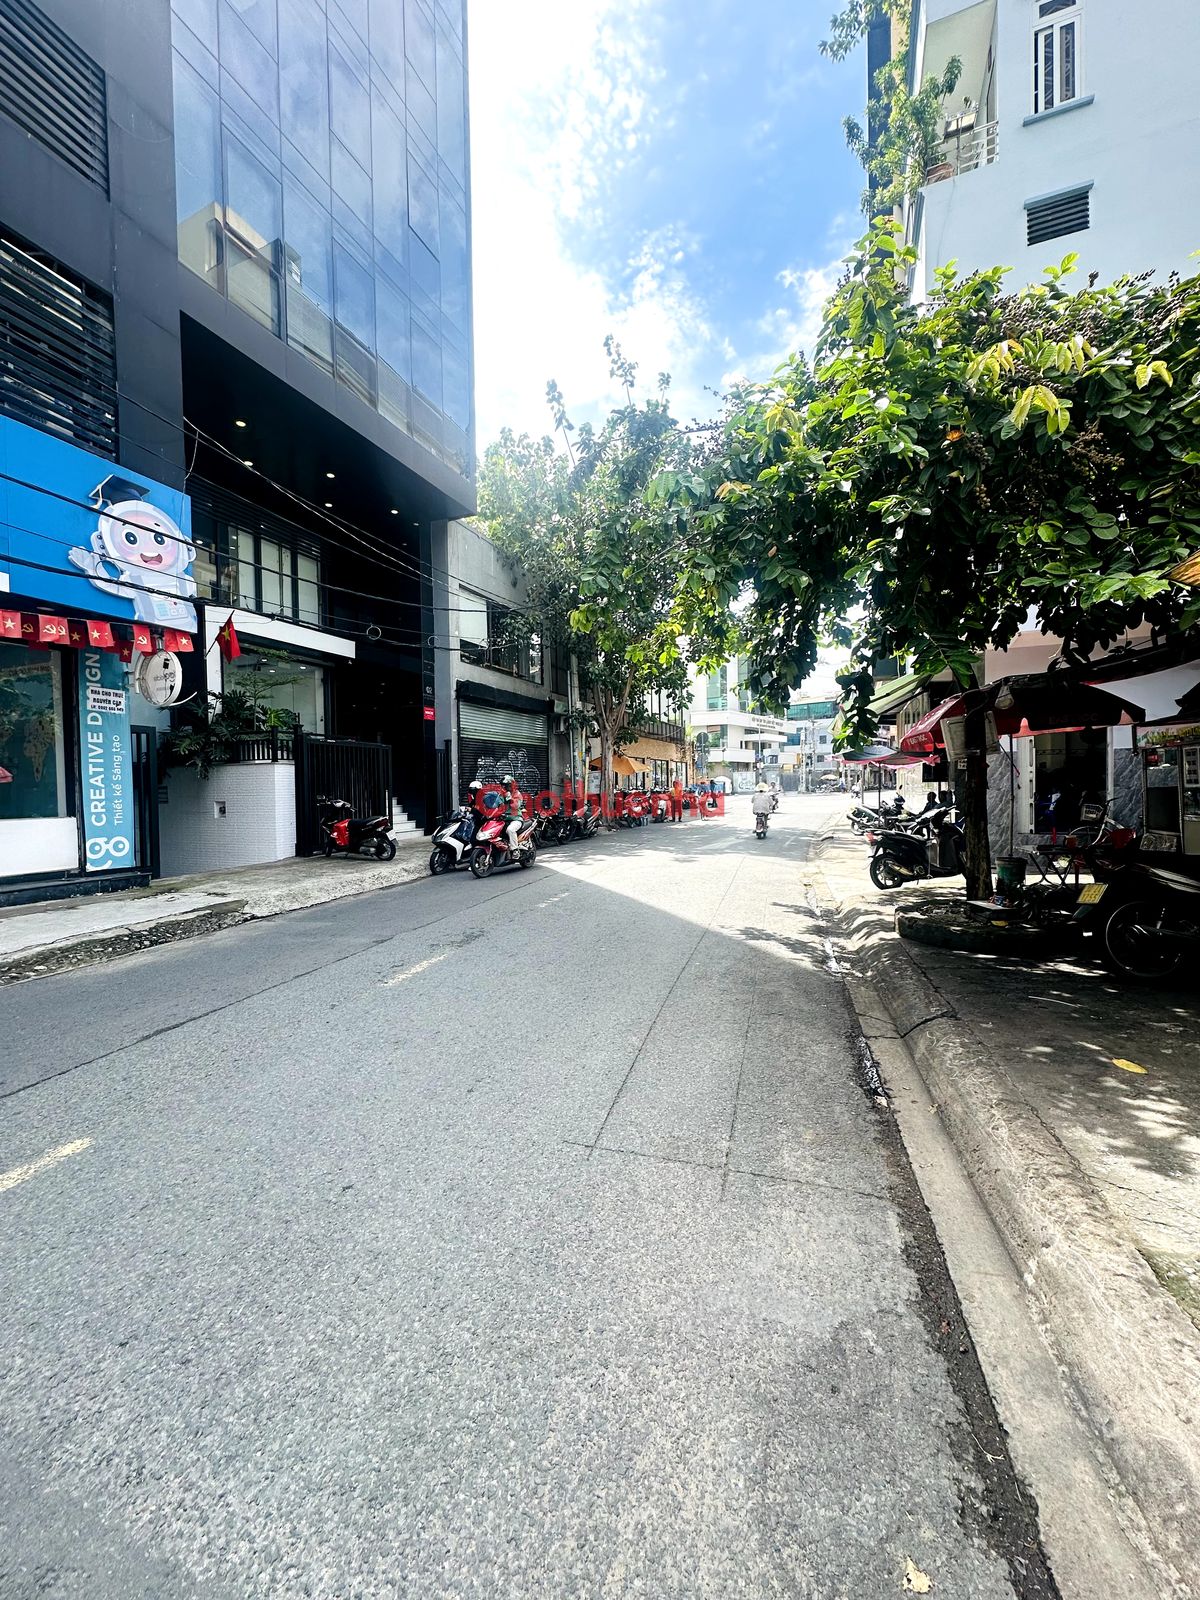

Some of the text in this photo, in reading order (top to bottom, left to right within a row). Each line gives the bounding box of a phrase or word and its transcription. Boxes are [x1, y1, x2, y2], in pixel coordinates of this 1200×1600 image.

[85, 653, 107, 827] CREATIVE DIGN
[111, 735, 124, 827] Thiết kế Sáng tạo
